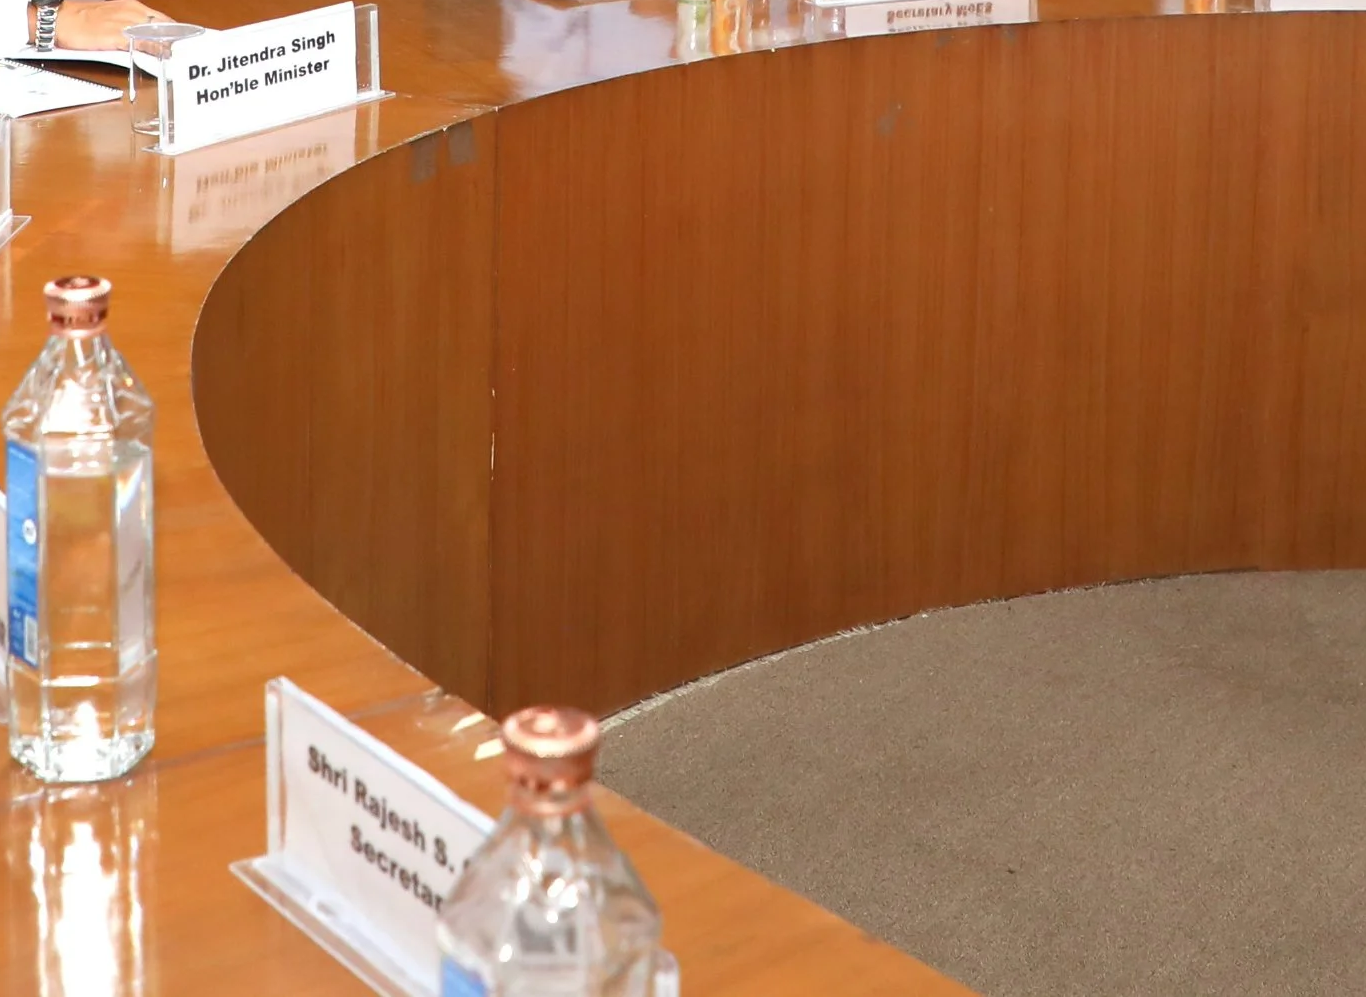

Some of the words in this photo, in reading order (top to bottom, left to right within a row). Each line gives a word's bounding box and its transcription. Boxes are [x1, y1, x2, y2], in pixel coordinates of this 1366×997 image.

[188, 64, 211, 80] Dr.
[217, 45, 286, 73] Jitendra
[291, 31, 335, 53] Singh
[264, 59, 330, 86] Minister
[308, 745, 347, 794] Shri
[354, 778, 426, 852] Rajesh
[434, 834, 455, 874] S.
[351, 824, 443, 914] Secretar
